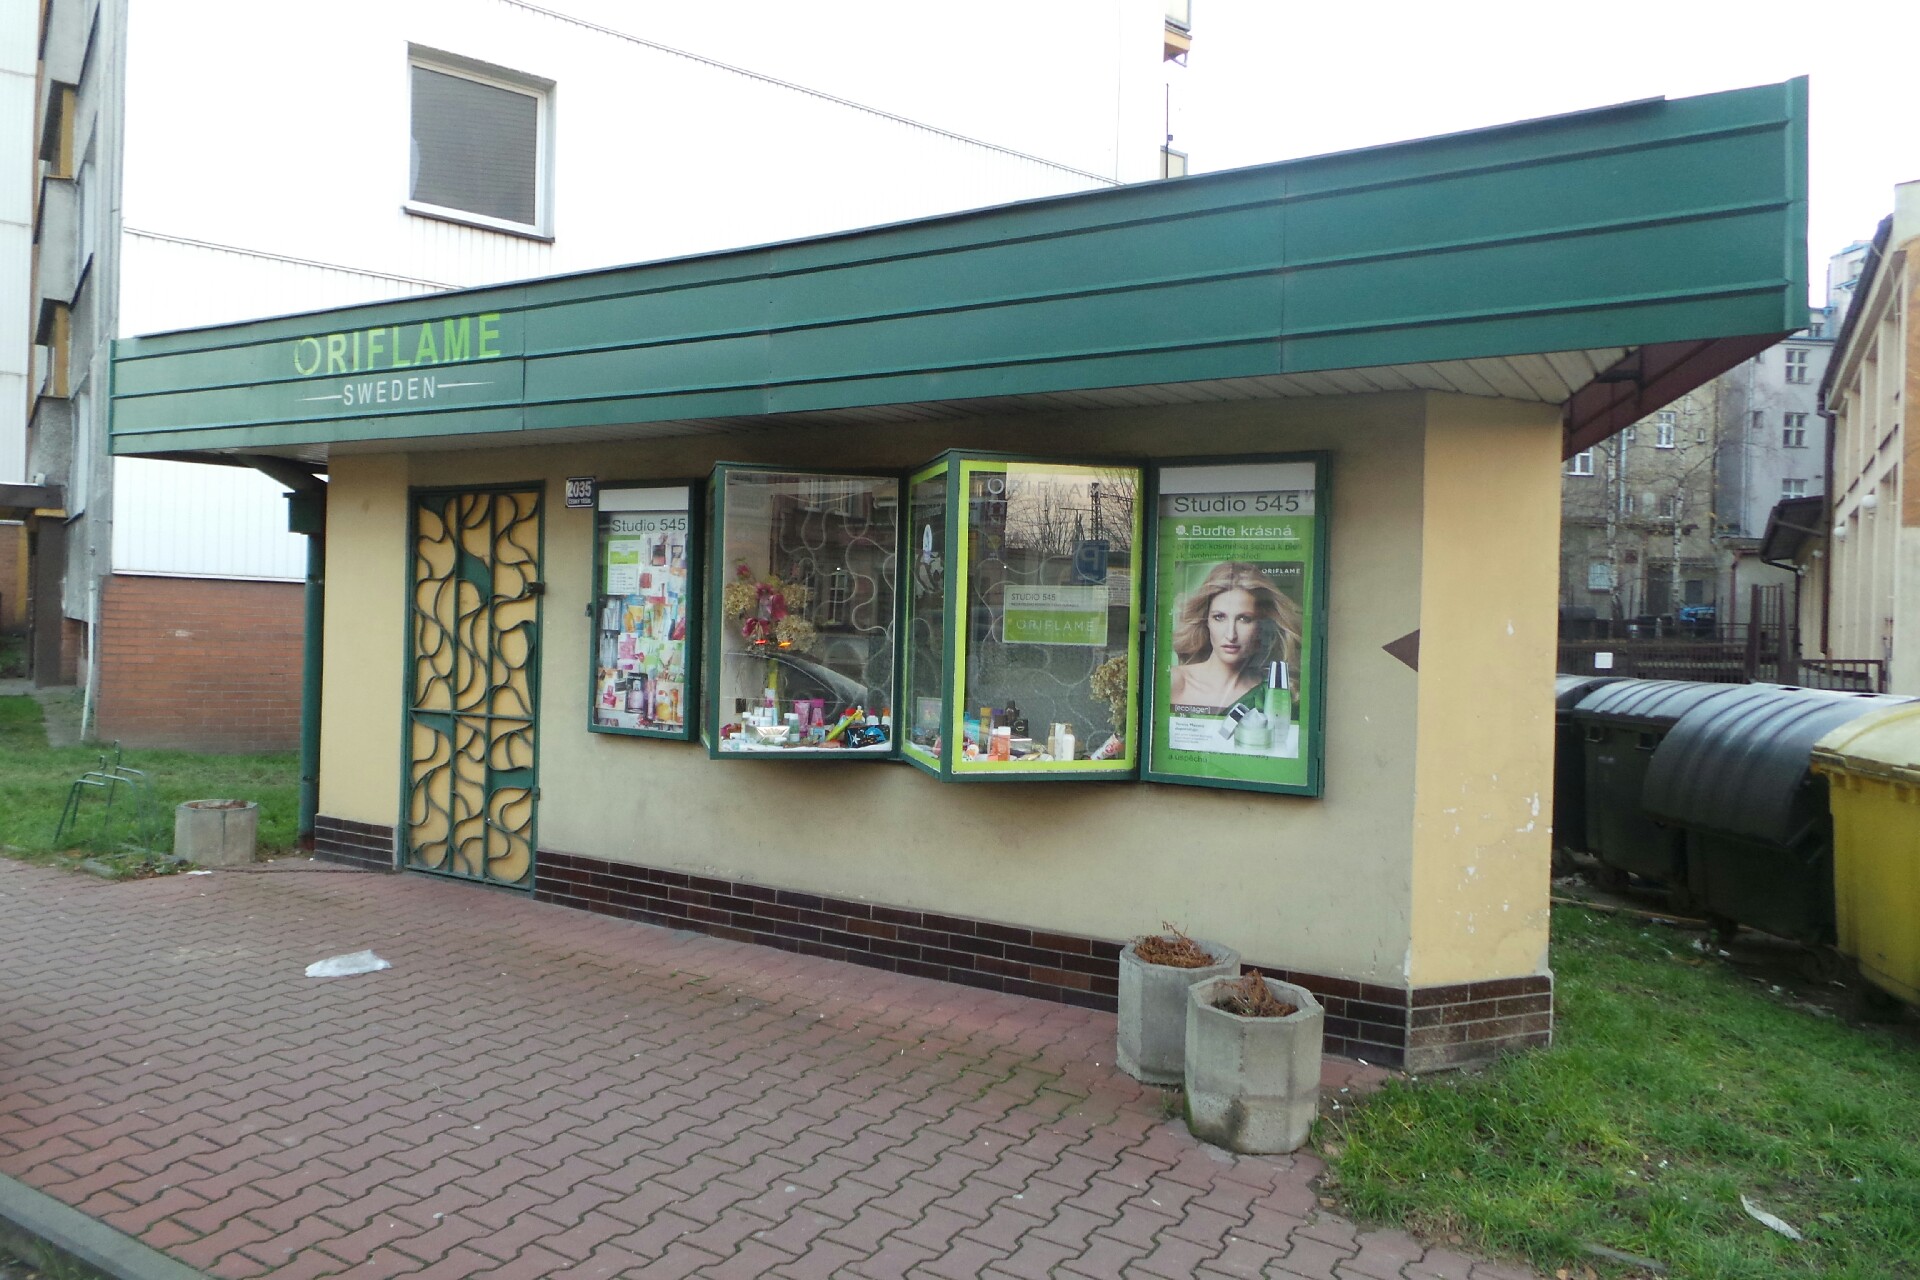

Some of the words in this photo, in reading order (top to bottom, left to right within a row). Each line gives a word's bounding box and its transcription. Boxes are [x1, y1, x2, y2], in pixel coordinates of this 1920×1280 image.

[294, 312, 501, 376] ORIFLAME
[343, 375, 436, 406] SWEDEN
[567, 480, 592, 498] 2035
[1174, 495, 1246, 512] Studio
[1255, 494, 1299, 512] 545
[611, 518, 656, 532] Studio
[660, 518, 686, 531] 545
[1191, 524, 1236, 536] Buďte
[1240, 524, 1292, 536] krásná
[1011, 592, 1040, 601] STUDIO
[1042, 592, 1056, 601] 545
[1016, 619, 1095, 632] ORIFLAME
